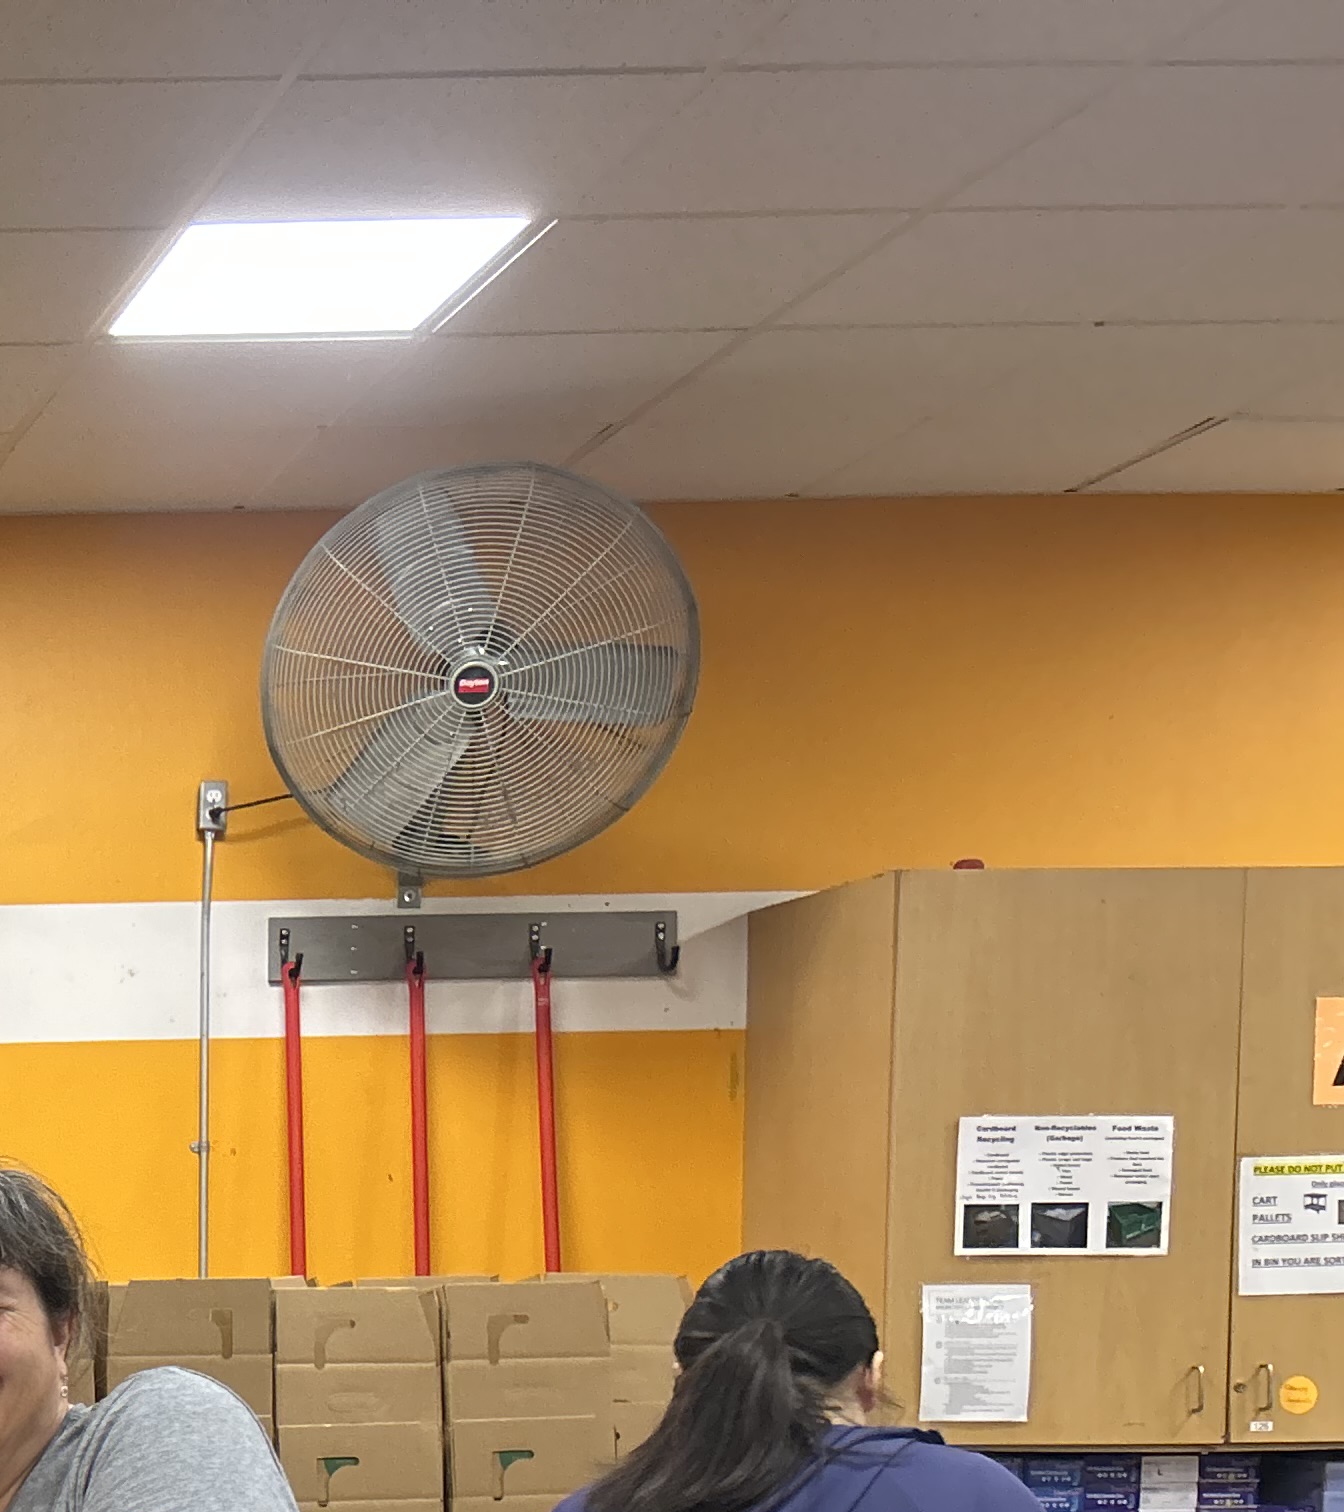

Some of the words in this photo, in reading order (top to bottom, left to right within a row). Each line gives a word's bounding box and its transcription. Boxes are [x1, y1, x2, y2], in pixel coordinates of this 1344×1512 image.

[1253, 1165, 1285, 1174] PLEASE
[1287, 1165, 1302, 1174] DO
[1304, 1164, 1323, 1173] NOT
[1325, 1164, 1343, 1172] PUT
[1252, 1195, 1278, 1206] CART
[1252, 1213, 1292, 1223] PALLETS
[1251, 1233, 1309, 1244] CARDBOARD
[1310, 1233, 1330, 1242] SLIP
[1281, 1258, 1302, 1266] YOU
[1303, 1257, 1321, 1266] ARE
